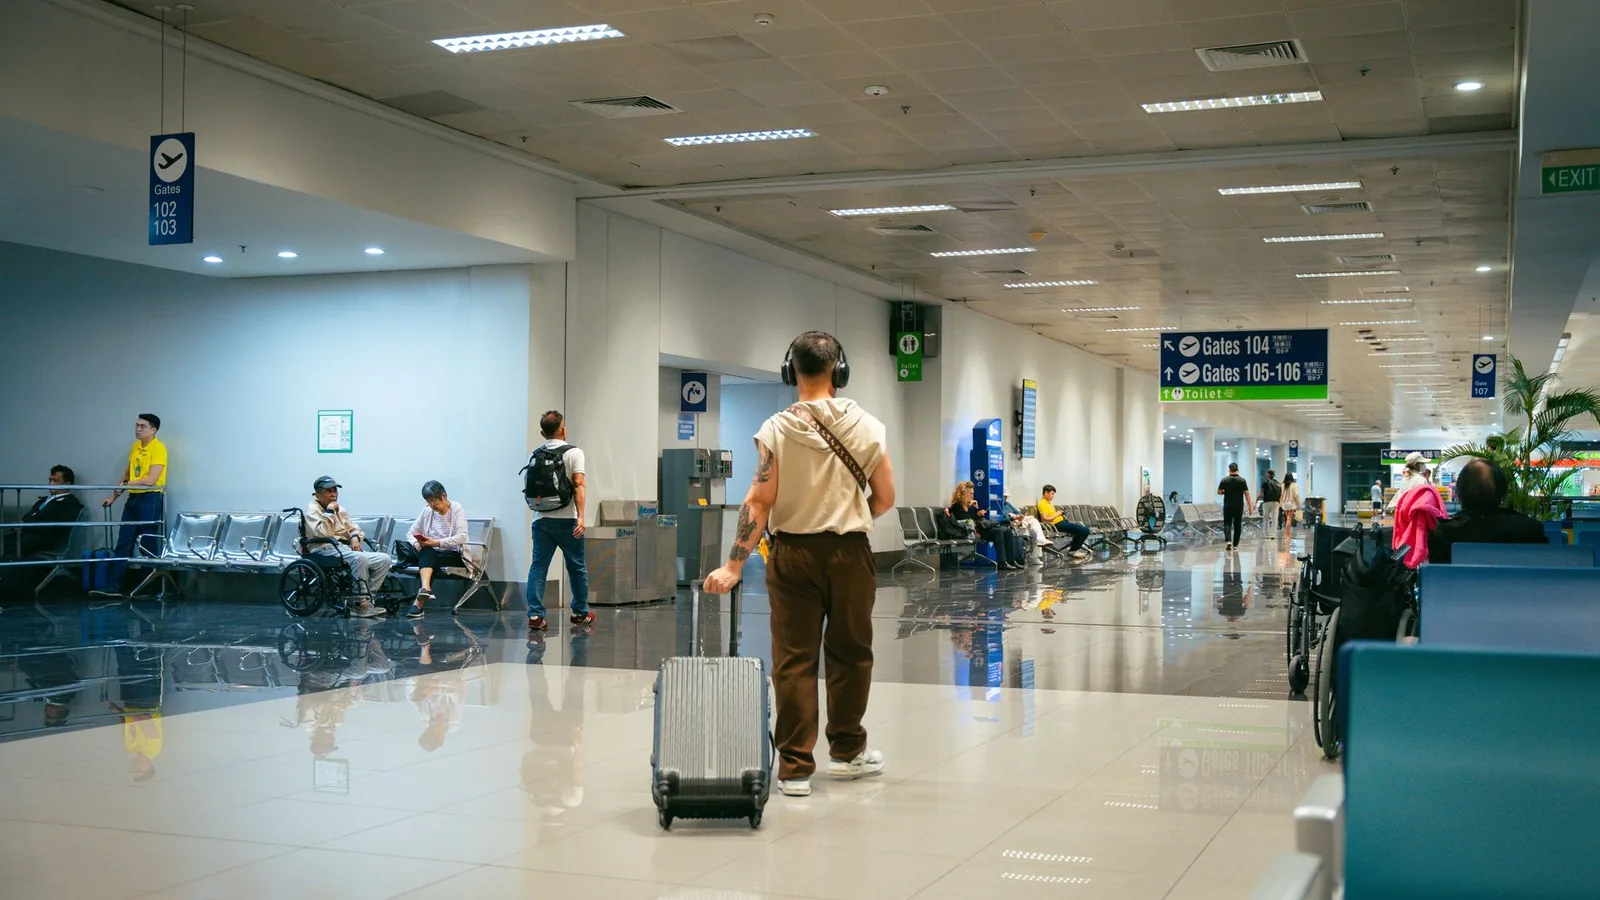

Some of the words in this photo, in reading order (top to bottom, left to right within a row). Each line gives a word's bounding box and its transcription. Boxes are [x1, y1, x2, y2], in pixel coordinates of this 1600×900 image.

[1559, 168, 1596, 187] EXIT
[154, 184, 181, 195] Gates
[154, 201, 177, 218] 102
[154, 219, 177, 236] 103
[1202, 336, 1240, 356] Gates
[1244, 335, 1270, 355] 104
[1202, 363, 1240, 383] Gates
[1244, 362, 1301, 382] 105-106
[1185, 388, 1222, 399] Toilet
[1474, 387, 1489, 395] 107
